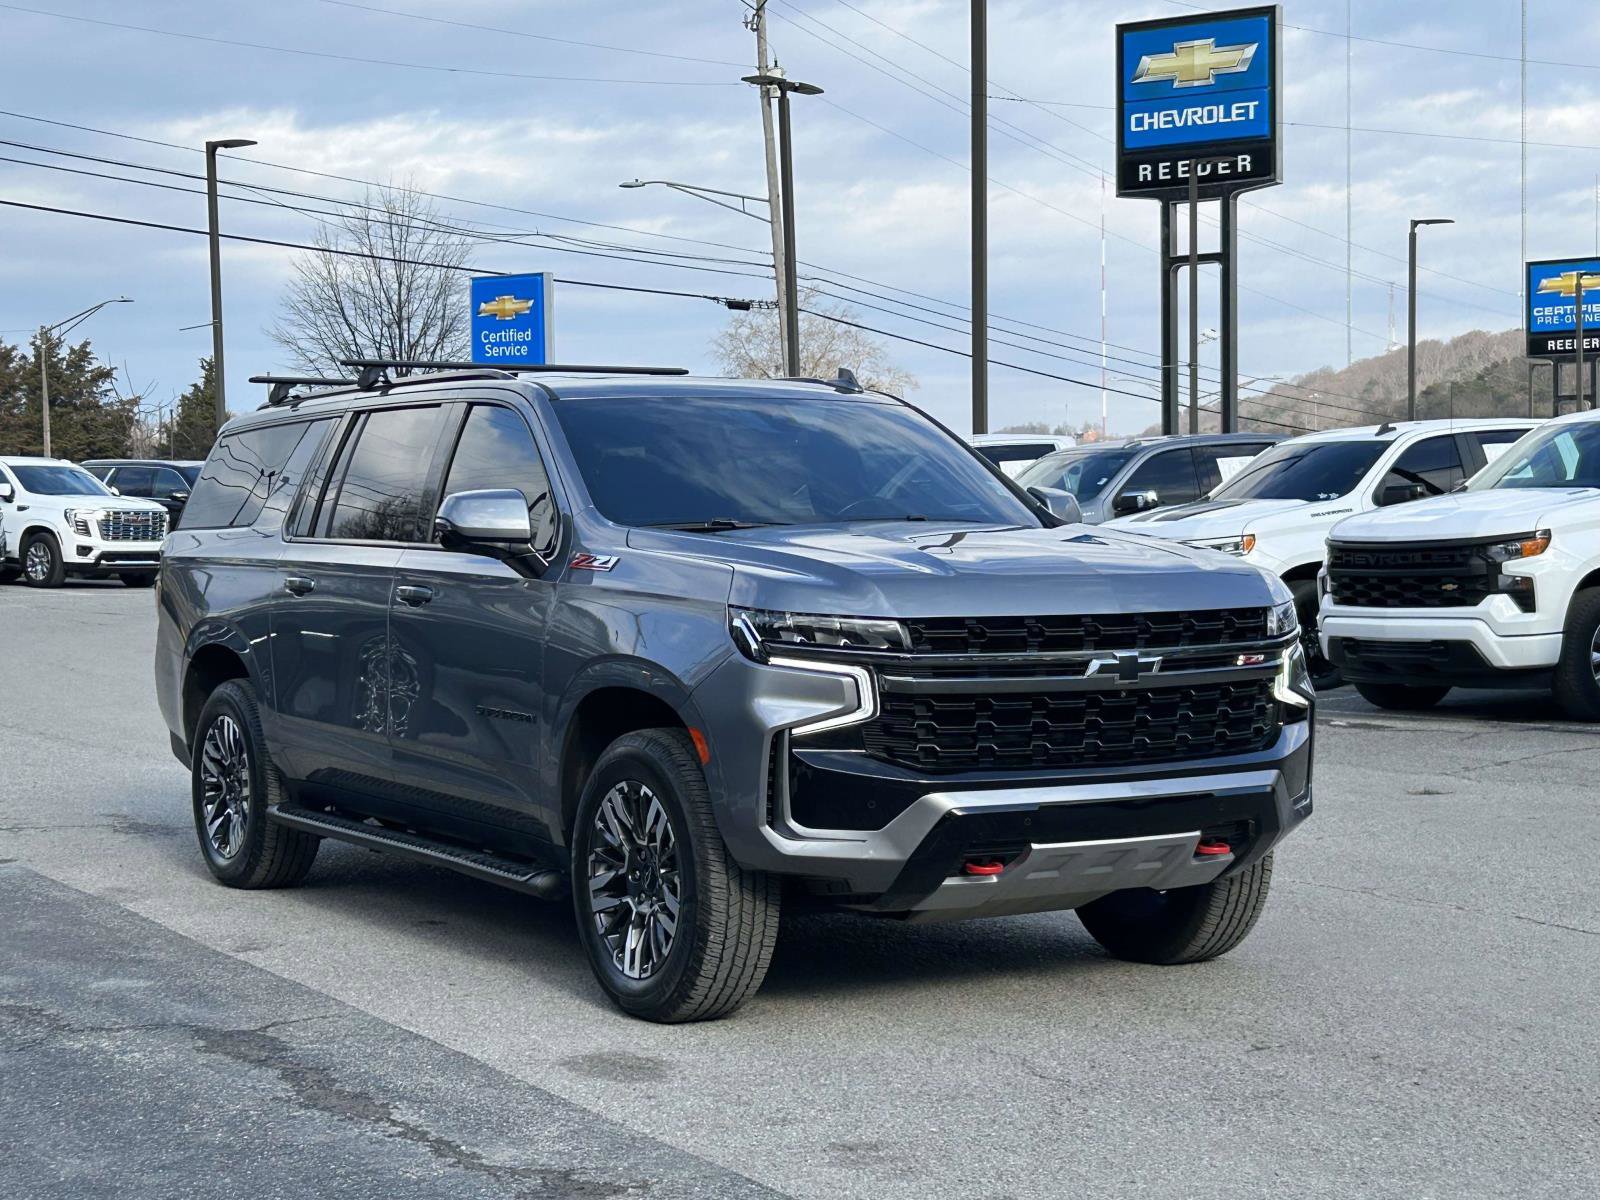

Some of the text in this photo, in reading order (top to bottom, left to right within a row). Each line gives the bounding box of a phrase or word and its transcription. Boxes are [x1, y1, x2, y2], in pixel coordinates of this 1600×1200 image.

[1130, 101, 1259, 132] CHEVROLET
[481, 328, 531, 343] Certified
[485, 343, 528, 357] Service
[569, 552, 621, 573] Z71
